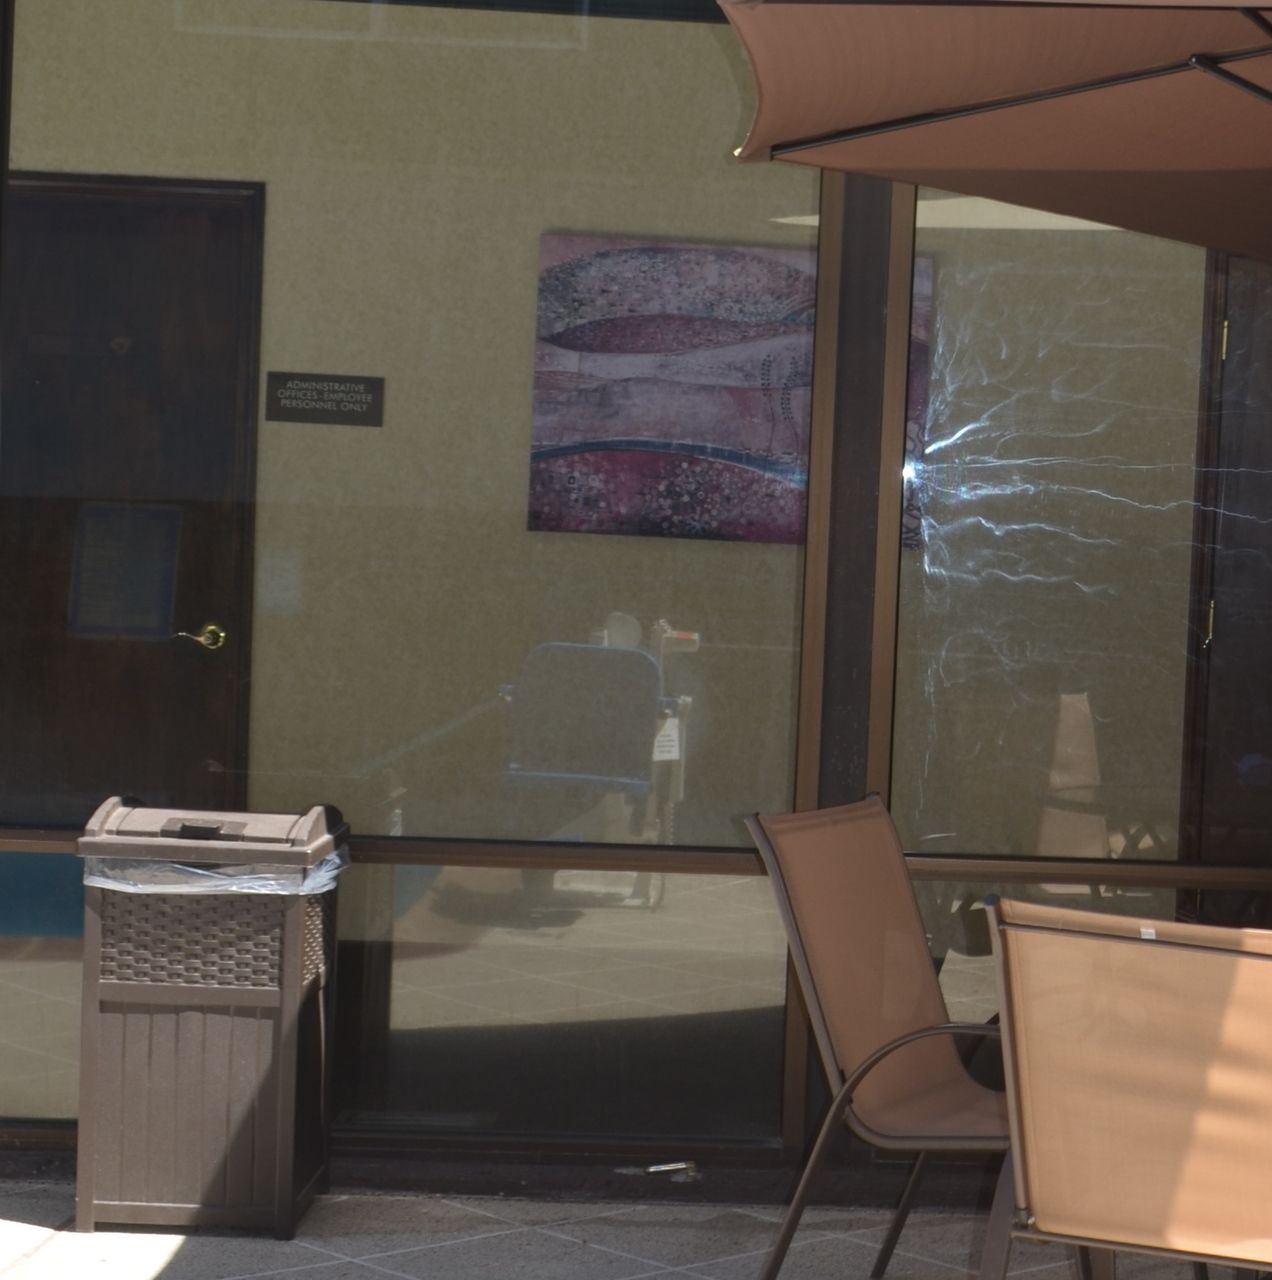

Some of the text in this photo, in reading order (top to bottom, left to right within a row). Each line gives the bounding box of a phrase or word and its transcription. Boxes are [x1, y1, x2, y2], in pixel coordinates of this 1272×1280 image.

[286, 380, 365, 393] ADMINISTRATIVE
[277, 388, 318, 400] OFFICES
[323, 391, 373, 403] EMPLOYEE
[280, 398, 369, 412] PERSONNEL ONLY
